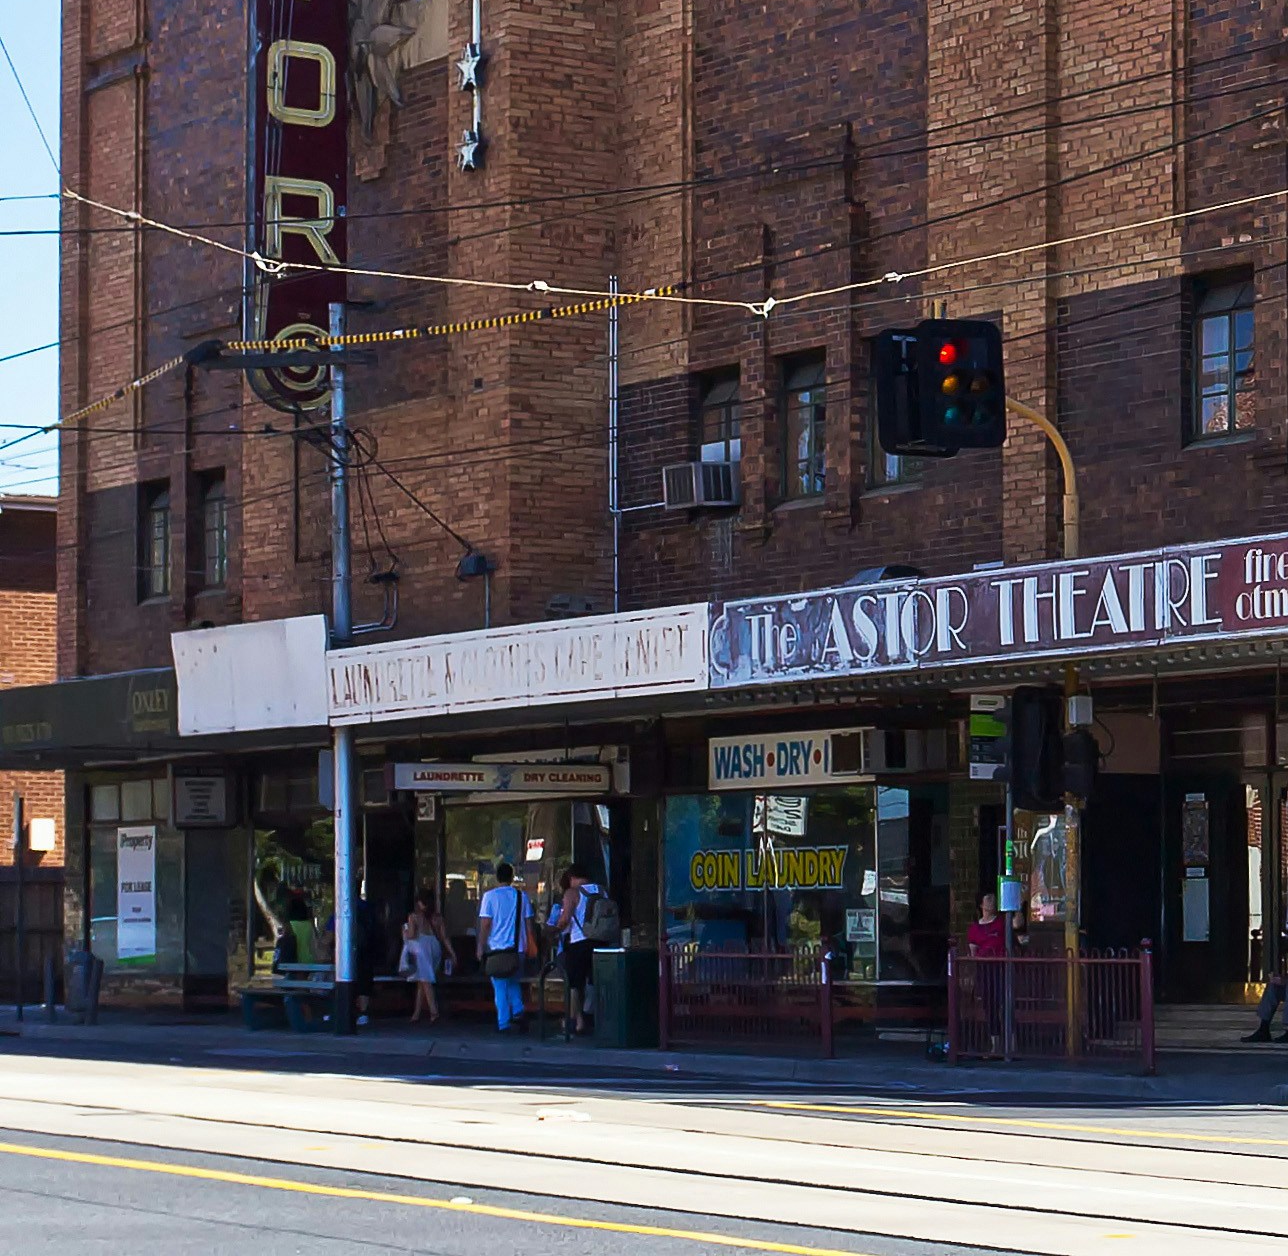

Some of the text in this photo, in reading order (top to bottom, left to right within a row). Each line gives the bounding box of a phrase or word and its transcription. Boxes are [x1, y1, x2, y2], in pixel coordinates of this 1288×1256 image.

[745, 552, 1224, 663] The ASTOR THEATRE
[413, 772, 602, 783] LAUNDRETTE DRY CLEANING
[714, 744, 765, 780] WASH
[776, 740, 813, 776] DRY
[690, 845, 849, 892] COIN LAUNDRY
